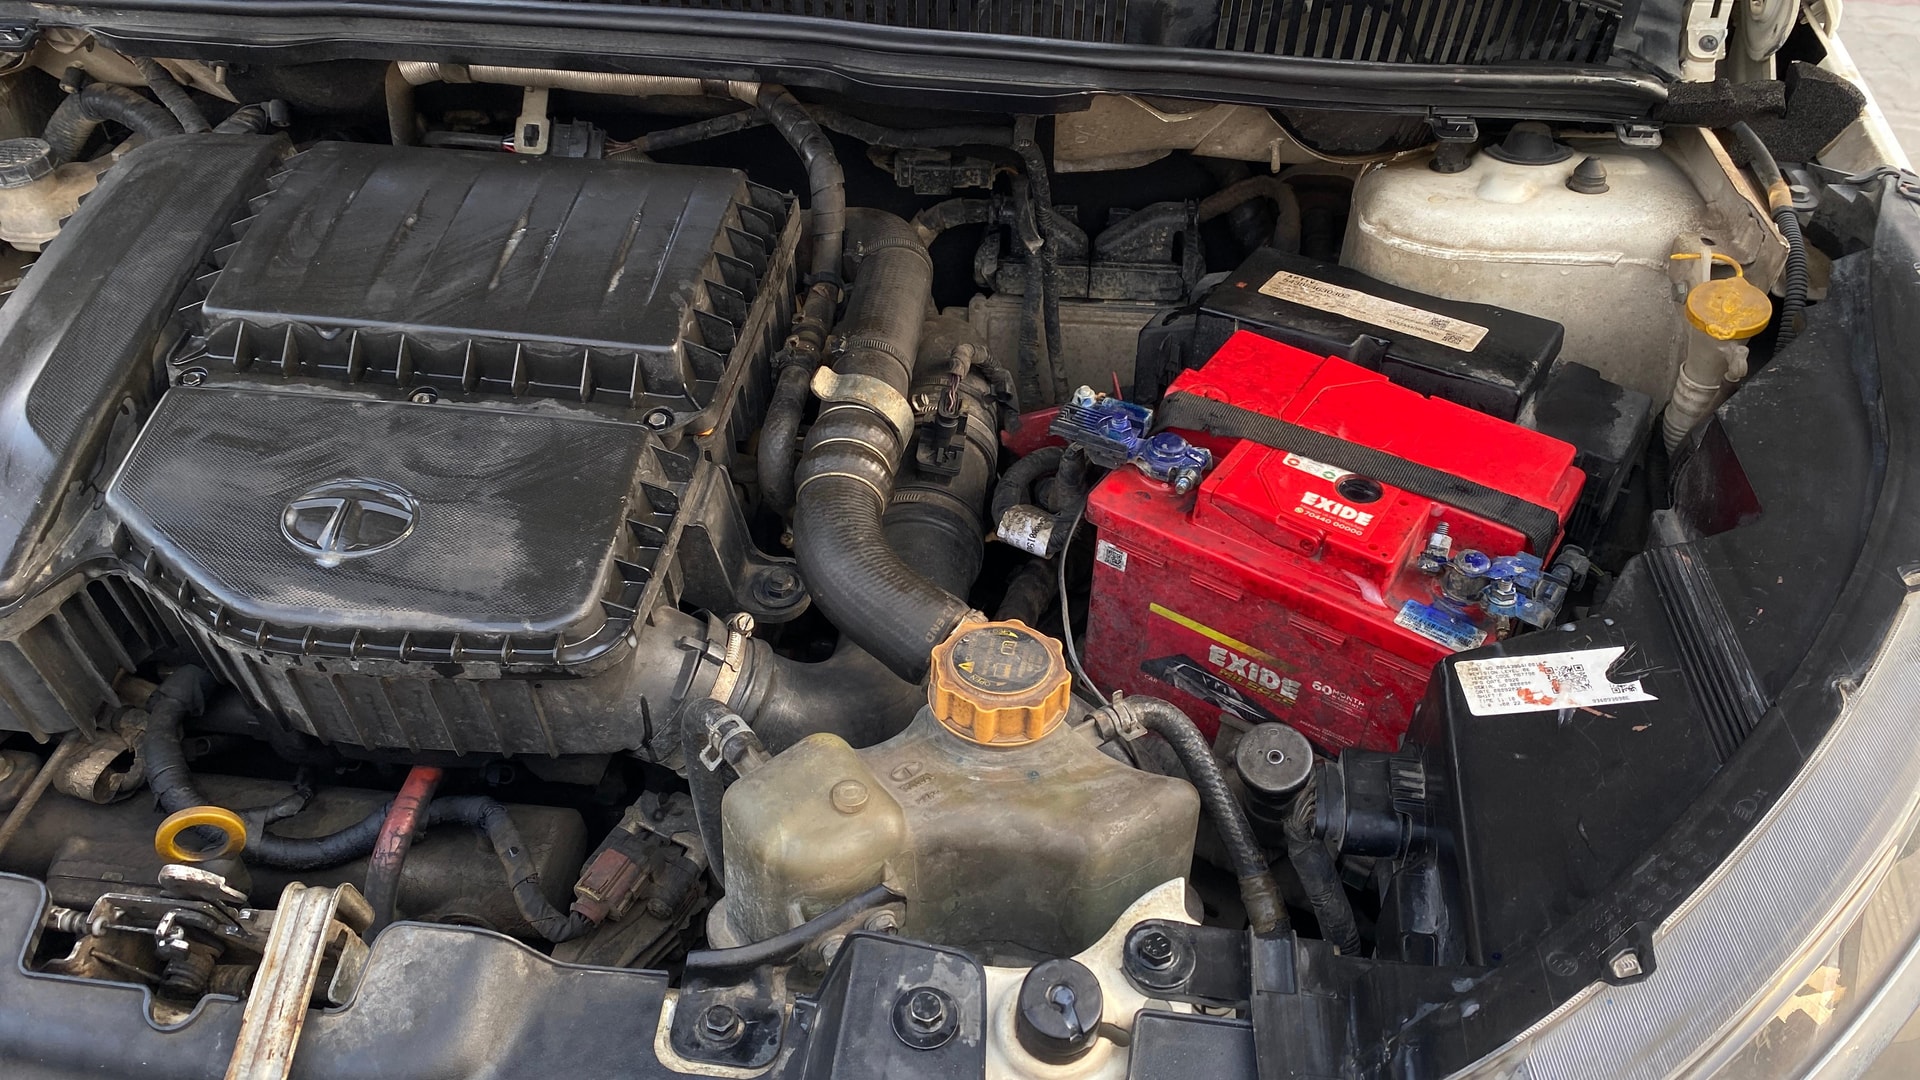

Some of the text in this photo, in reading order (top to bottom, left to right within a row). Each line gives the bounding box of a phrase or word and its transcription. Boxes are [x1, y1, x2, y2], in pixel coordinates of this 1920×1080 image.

[1301, 491, 1374, 526] EXIDE
[1304, 511, 1331, 524] 70440
[1333, 521, 1362, 535] 00000
[971, 674, 991, 688] OPEN
[1208, 644, 1301, 699] EXIDE
[1311, 681, 1365, 708] 60 MONTH
